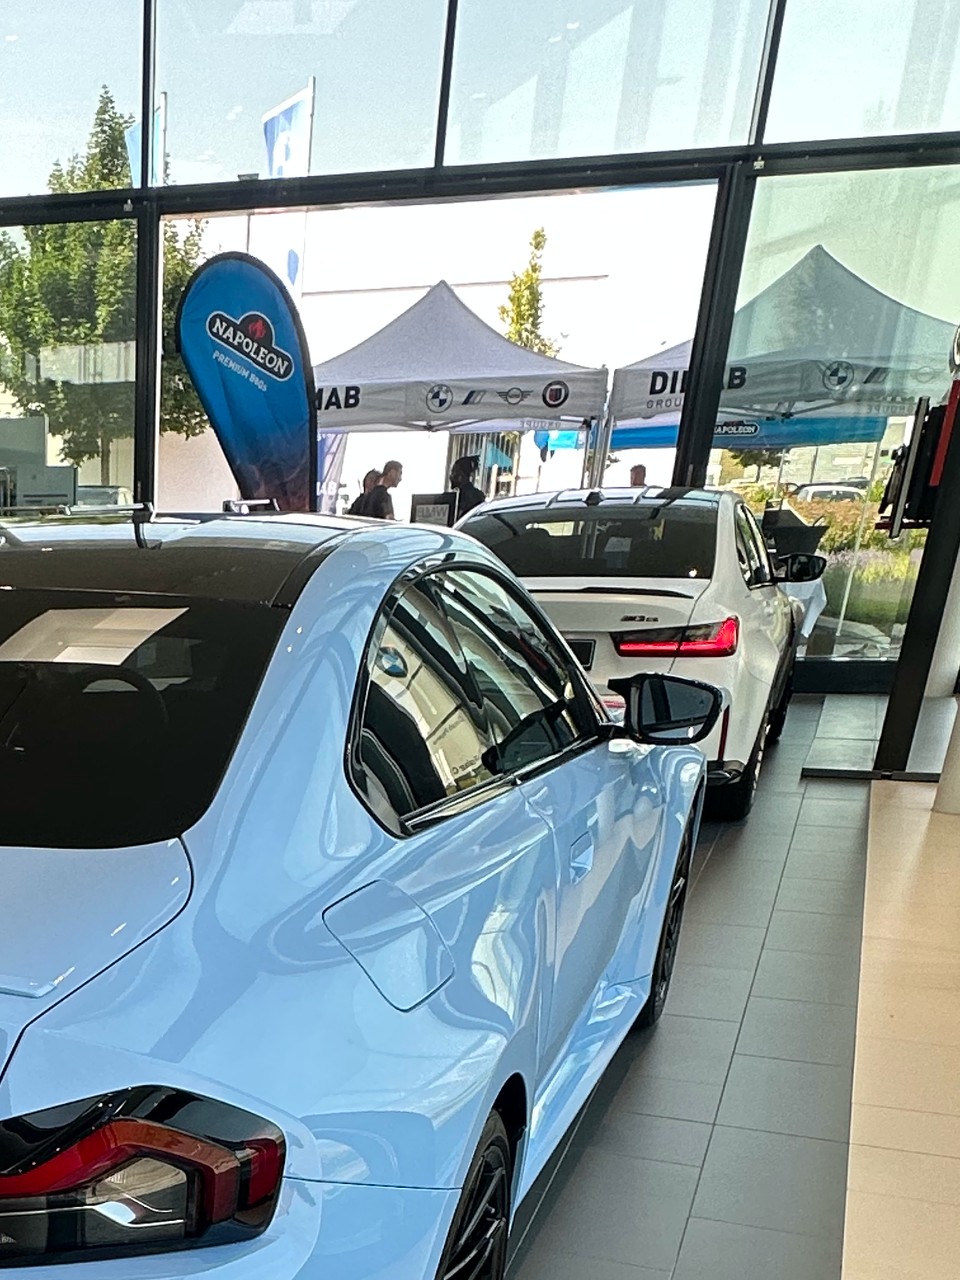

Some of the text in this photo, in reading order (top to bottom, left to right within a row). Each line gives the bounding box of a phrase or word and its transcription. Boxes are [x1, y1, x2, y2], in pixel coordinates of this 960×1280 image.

[211, 318, 289, 375] NAPOLEON
[212, 350, 249, 377] PREMIUM
[649, 366, 747, 395] DIB
[646, 399, 683, 409] GROU
